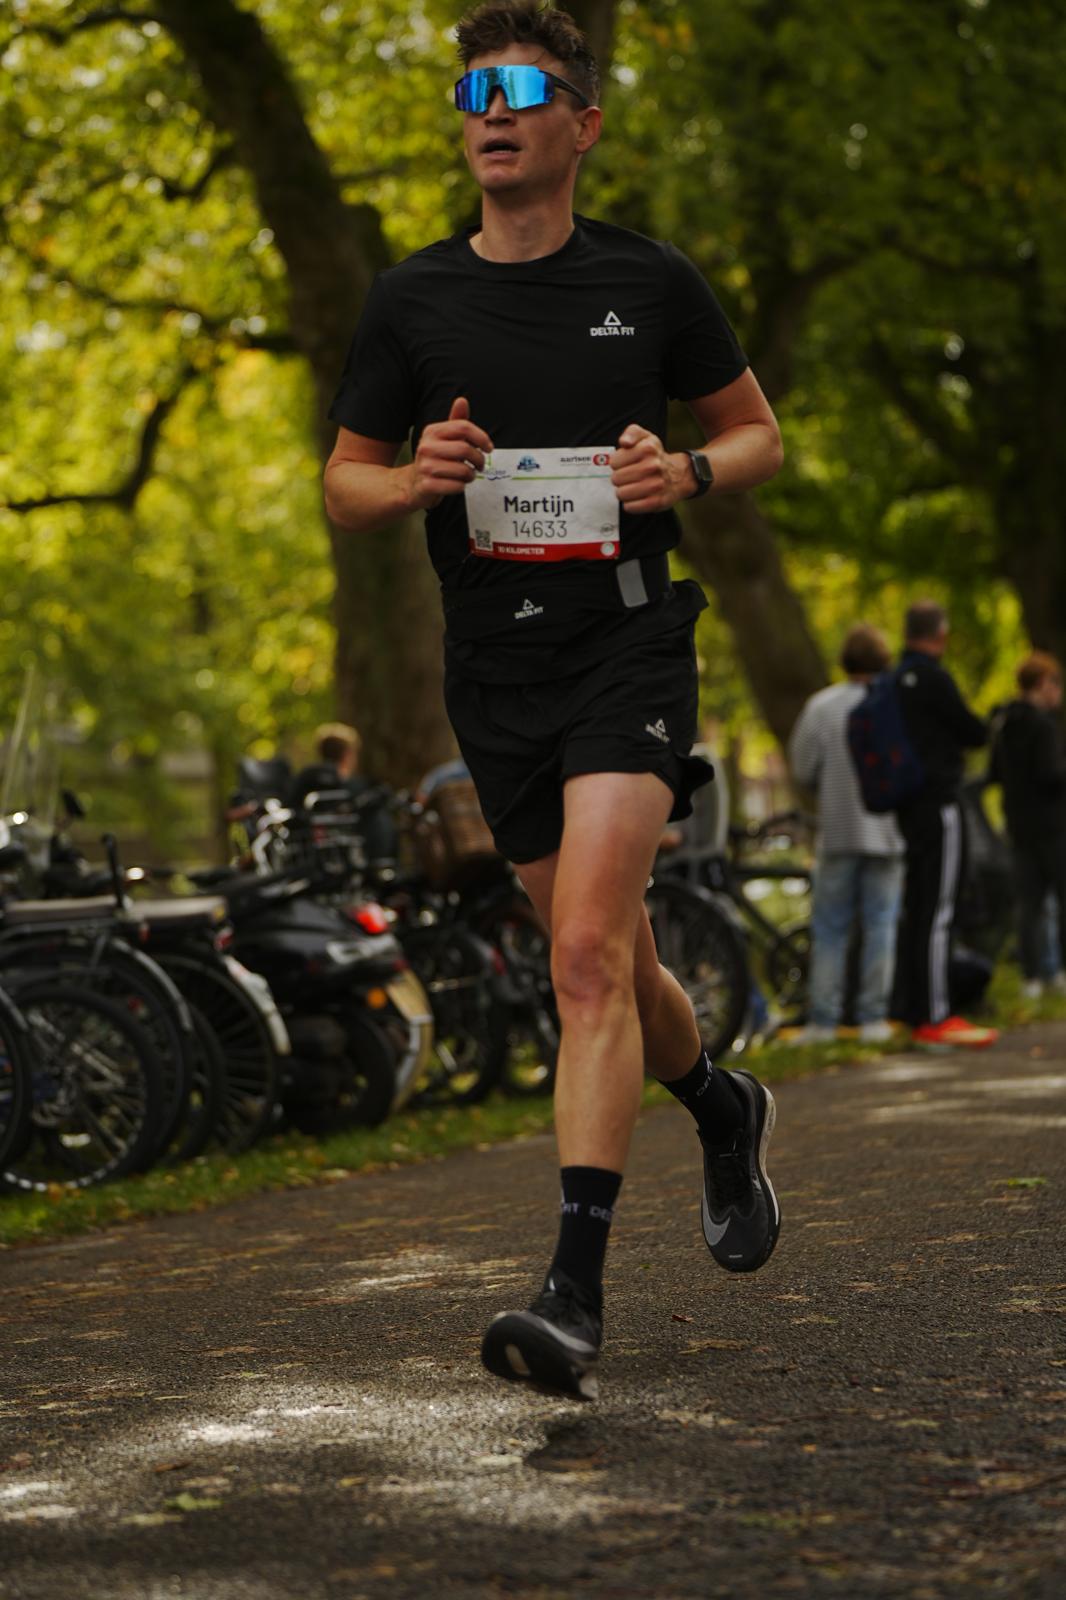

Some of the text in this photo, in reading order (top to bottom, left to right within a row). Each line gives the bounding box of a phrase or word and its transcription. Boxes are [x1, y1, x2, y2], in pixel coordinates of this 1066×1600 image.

[590, 326, 635, 337] DELTA FIT
[504, 496, 574, 517] Martijn
[513, 520, 567, 538] 14633
